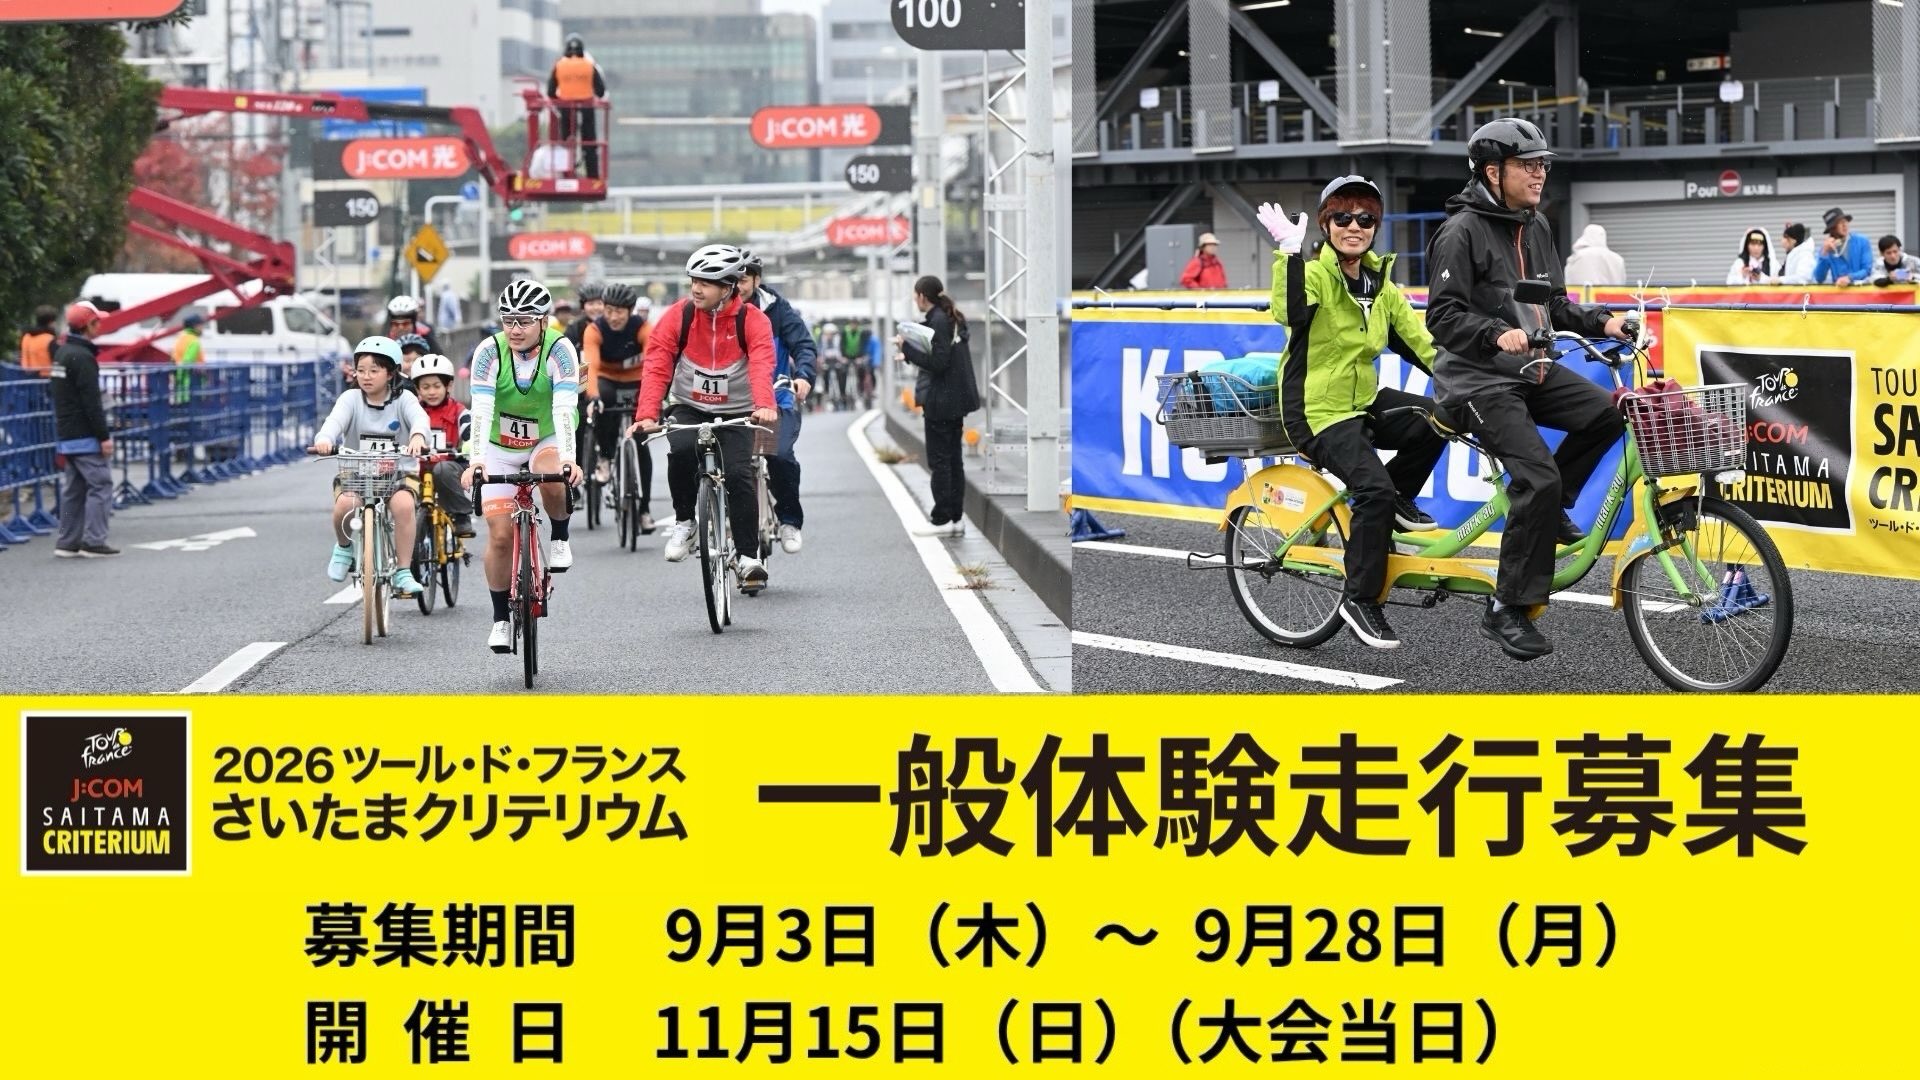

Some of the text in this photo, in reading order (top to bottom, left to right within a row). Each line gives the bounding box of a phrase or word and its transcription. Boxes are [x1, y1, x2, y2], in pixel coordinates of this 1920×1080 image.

[898, 0, 961, 28] 100
[765, 112, 867, 143] J:COM 光
[355, 144, 458, 174] J:COM 光
[848, 164, 880, 184] 150
[346, 198, 378, 217] 150
[701, 380, 720, 394] 41
[1871, 368, 1917, 397] TOU
[510, 421, 531, 439] 41
[1736, 451, 1830, 478] ITAMA
[1869, 466, 1920, 512] CR
[1457, 513, 1482, 542] mark
